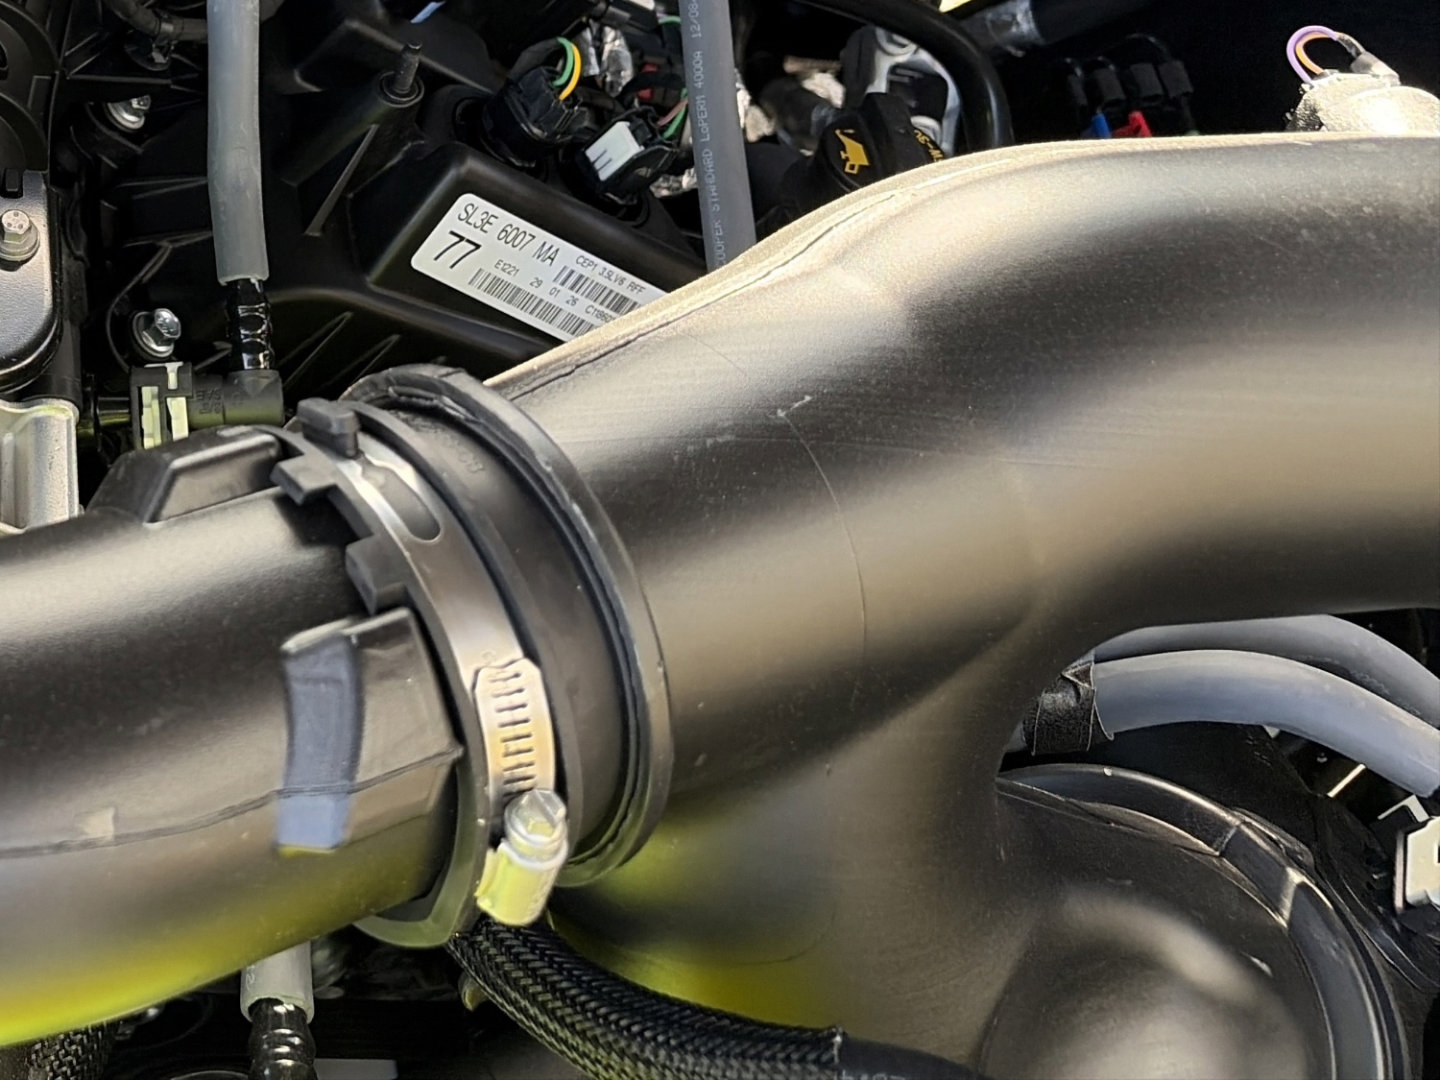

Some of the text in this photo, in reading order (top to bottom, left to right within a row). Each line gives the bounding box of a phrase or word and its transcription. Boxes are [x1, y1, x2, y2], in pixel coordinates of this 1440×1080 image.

[433, 229, 482, 270] 77
[457, 202, 561, 267] SL3E 6007 MA
[494, 258, 520, 277] E1221
[530, 277, 543, 289] 29
[549, 286, 560, 298] 01
[575, 254, 597, 272] CEP1
